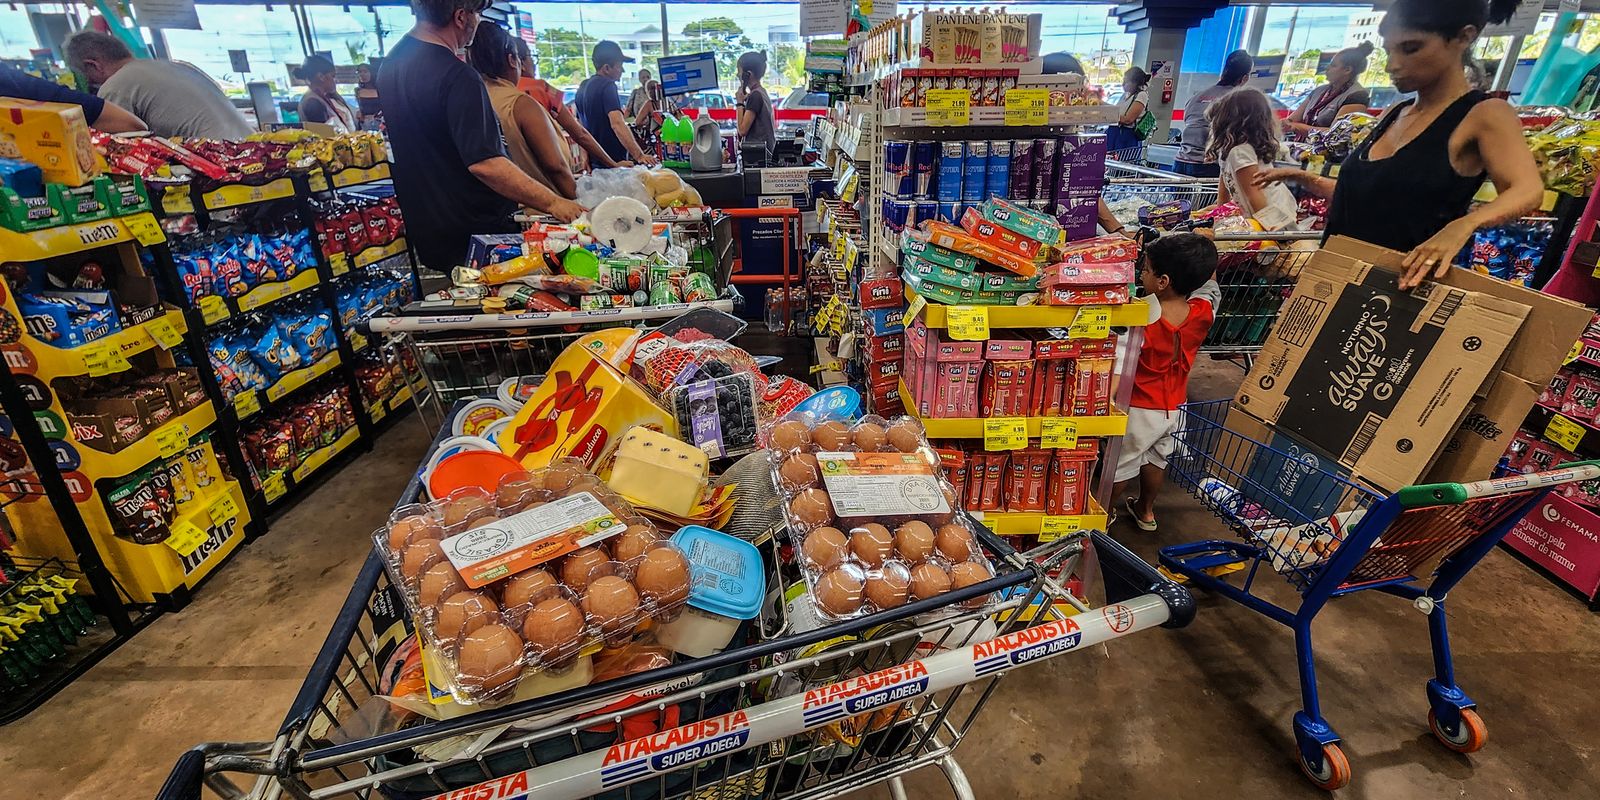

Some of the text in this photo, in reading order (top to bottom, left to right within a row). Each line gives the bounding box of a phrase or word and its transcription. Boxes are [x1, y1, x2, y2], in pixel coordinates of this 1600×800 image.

[937, 15, 980, 24] PANTENE
[983, 15, 1026, 24] PANTENE
[1062, 163, 1071, 192] Red Bull
[872, 286, 890, 296] Fini
[886, 311, 903, 322] Fini
[884, 339, 900, 349] Fini
[1341, 310, 1371, 355] NOTURNO
[881, 362, 898, 374] Fini
[1330, 313, 1389, 405] always
[1342, 352, 1386, 412] SUAVE
[1374, 348, 1415, 401] G ABSORVENTE
[1395, 362, 1412, 384] GRANDE
[906, 481, 932, 493] BRASIL
[1285, 472, 1300, 497] SUAVE
[1299, 521, 1332, 541] Ades
[1524, 521, 1566, 550] junto pela
[1560, 517, 1599, 543] FEMAMA
[465, 538, 505, 556] BRASIL
[1512, 527, 1576, 572] câncer de mama
[973, 618, 1080, 661] ATACADISTA
[1017, 638, 1076, 663] SUPER ADEGA
[643, 677, 694, 697] ilizável.
[803, 660, 928, 709] ATACADISTA
[854, 683, 922, 712] SUPER ADEGA
[601, 710, 749, 767] ATACADISTA
[661, 734, 741, 769] SUPER ADEGA
